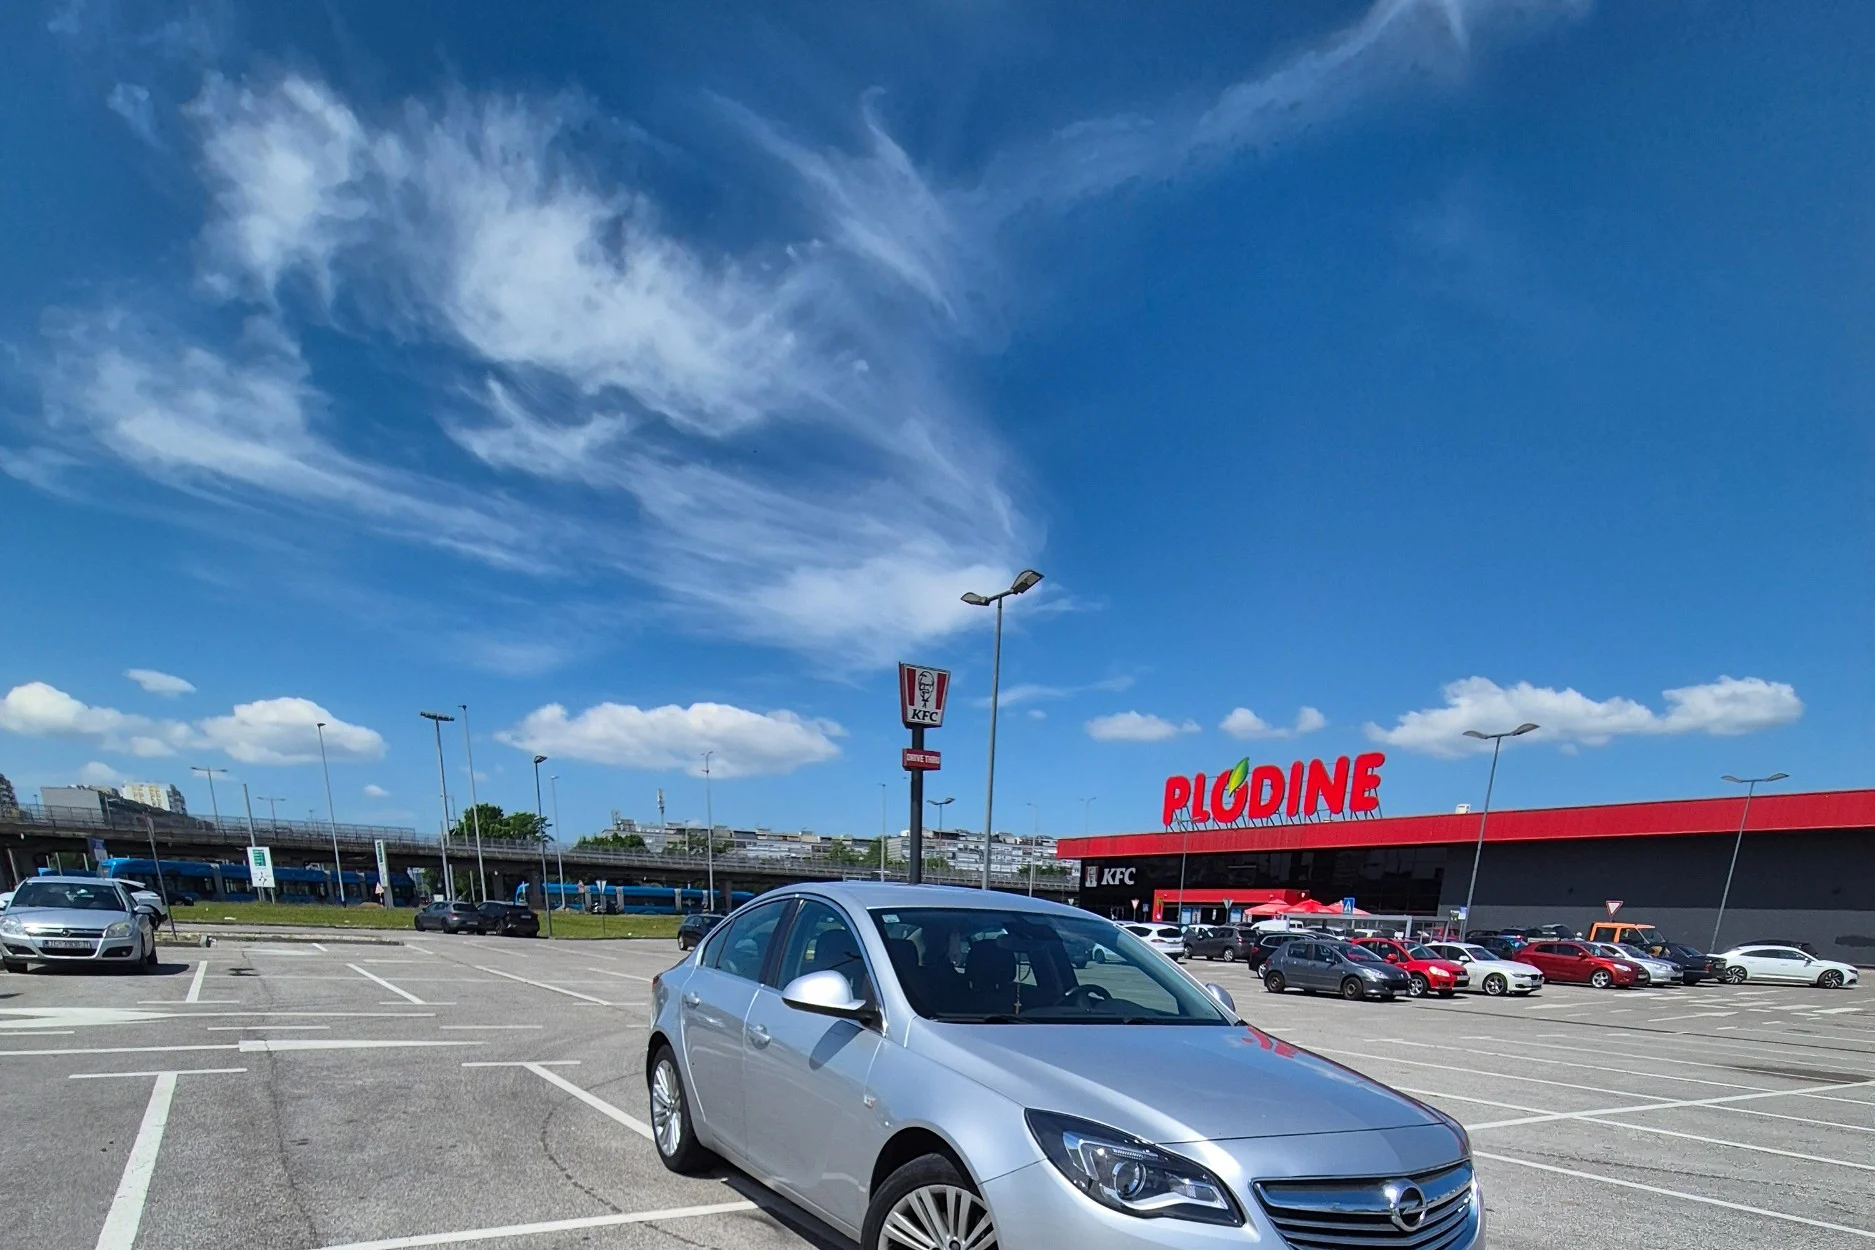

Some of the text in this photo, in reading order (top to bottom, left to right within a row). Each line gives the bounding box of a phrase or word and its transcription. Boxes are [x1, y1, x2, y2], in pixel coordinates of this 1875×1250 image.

[911, 708, 938, 722] KFC
[1163, 753, 1385, 826] PLODINE
[1101, 867, 1136, 885] KFC
